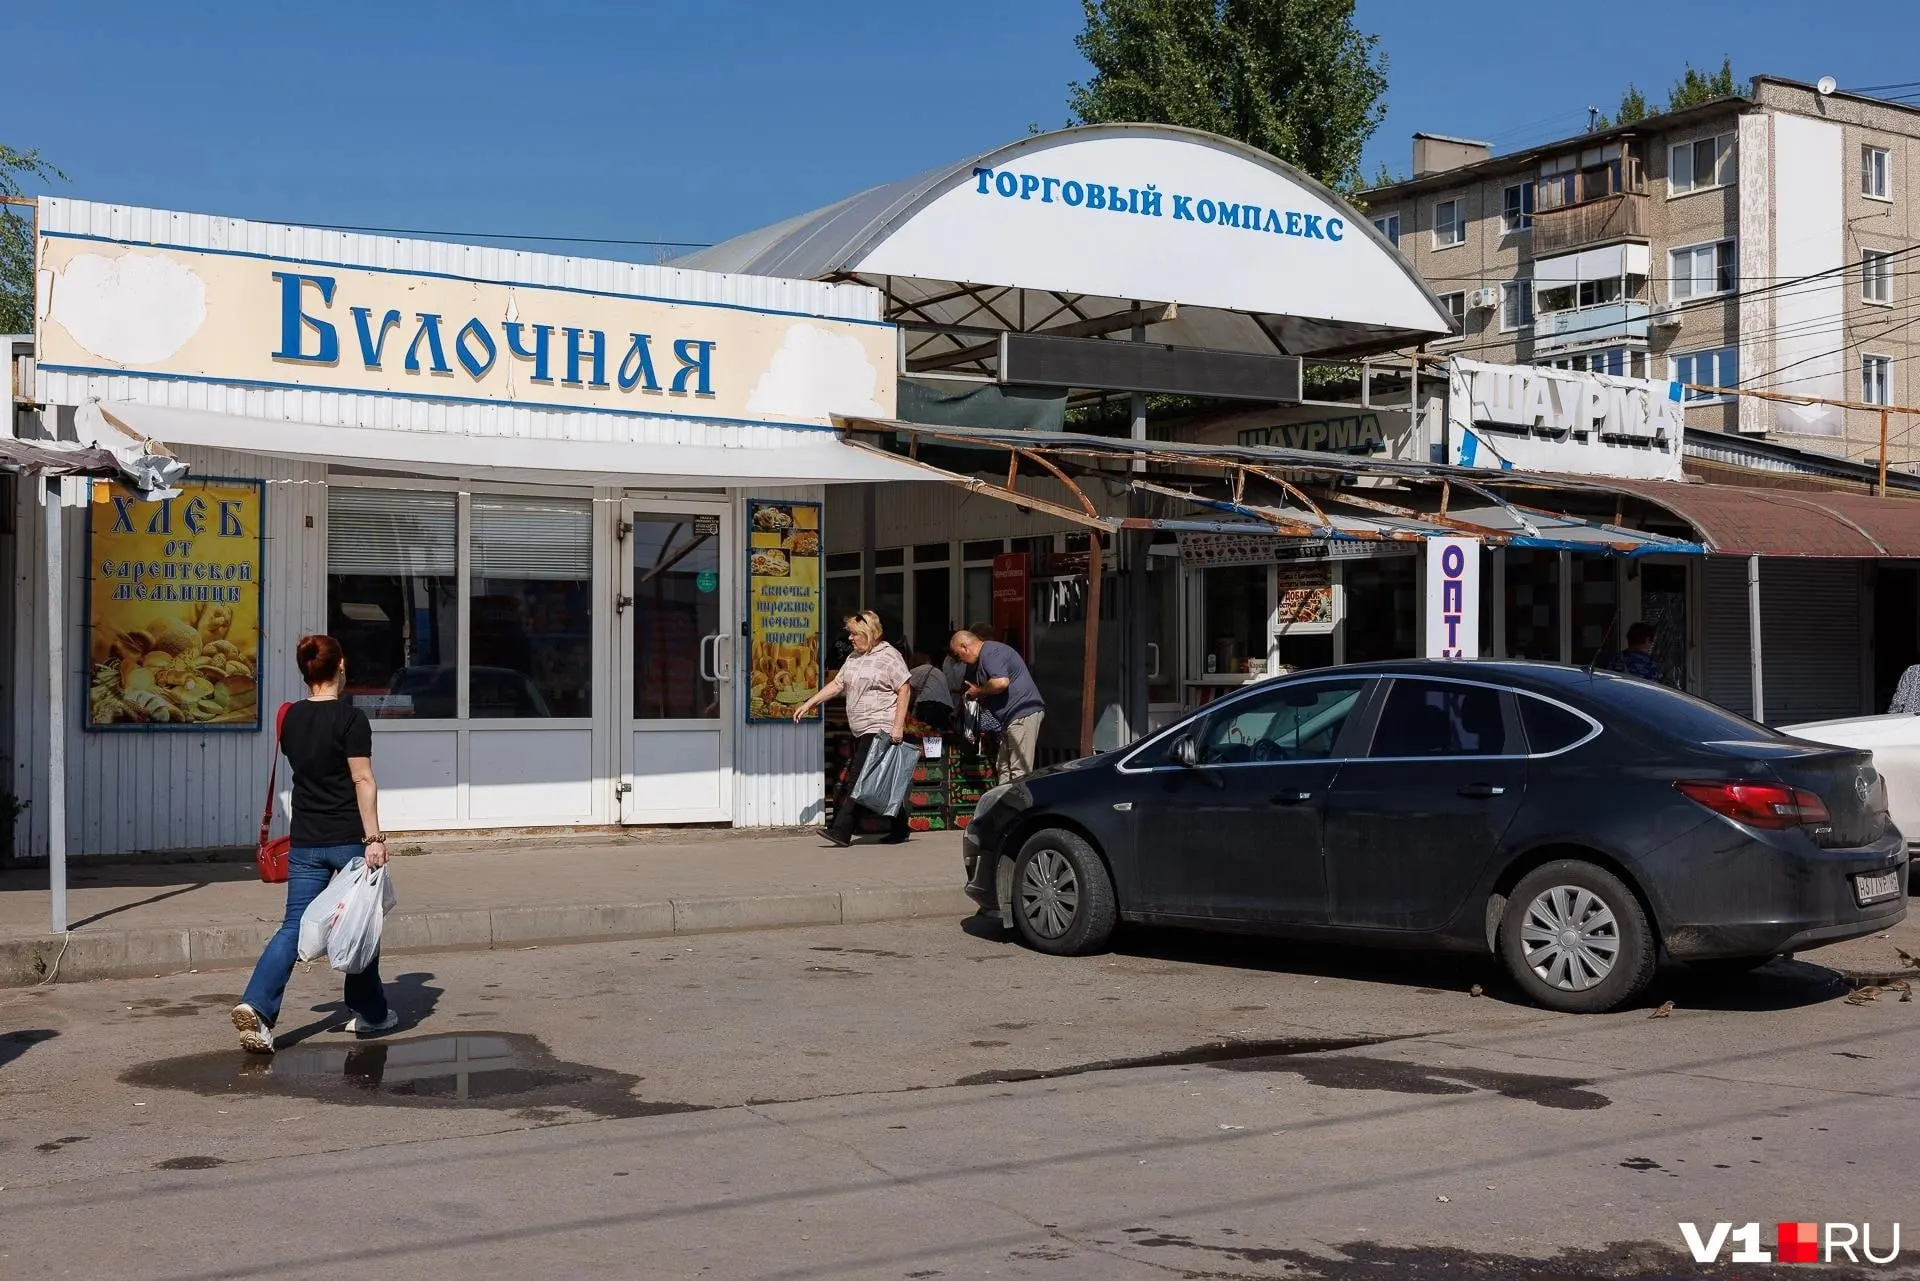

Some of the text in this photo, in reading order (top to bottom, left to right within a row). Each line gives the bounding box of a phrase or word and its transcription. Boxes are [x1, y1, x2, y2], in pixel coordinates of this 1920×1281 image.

[972, 167, 1344, 242] ТОРГОВЫЙ КОМПЛЕКС
[271, 271, 717, 396] Булочная
[1472, 371, 1670, 442] ШАУРМА
[111, 496, 244, 537] ХЛЕБ
[1441, 544, 1465, 659] ОПТ
